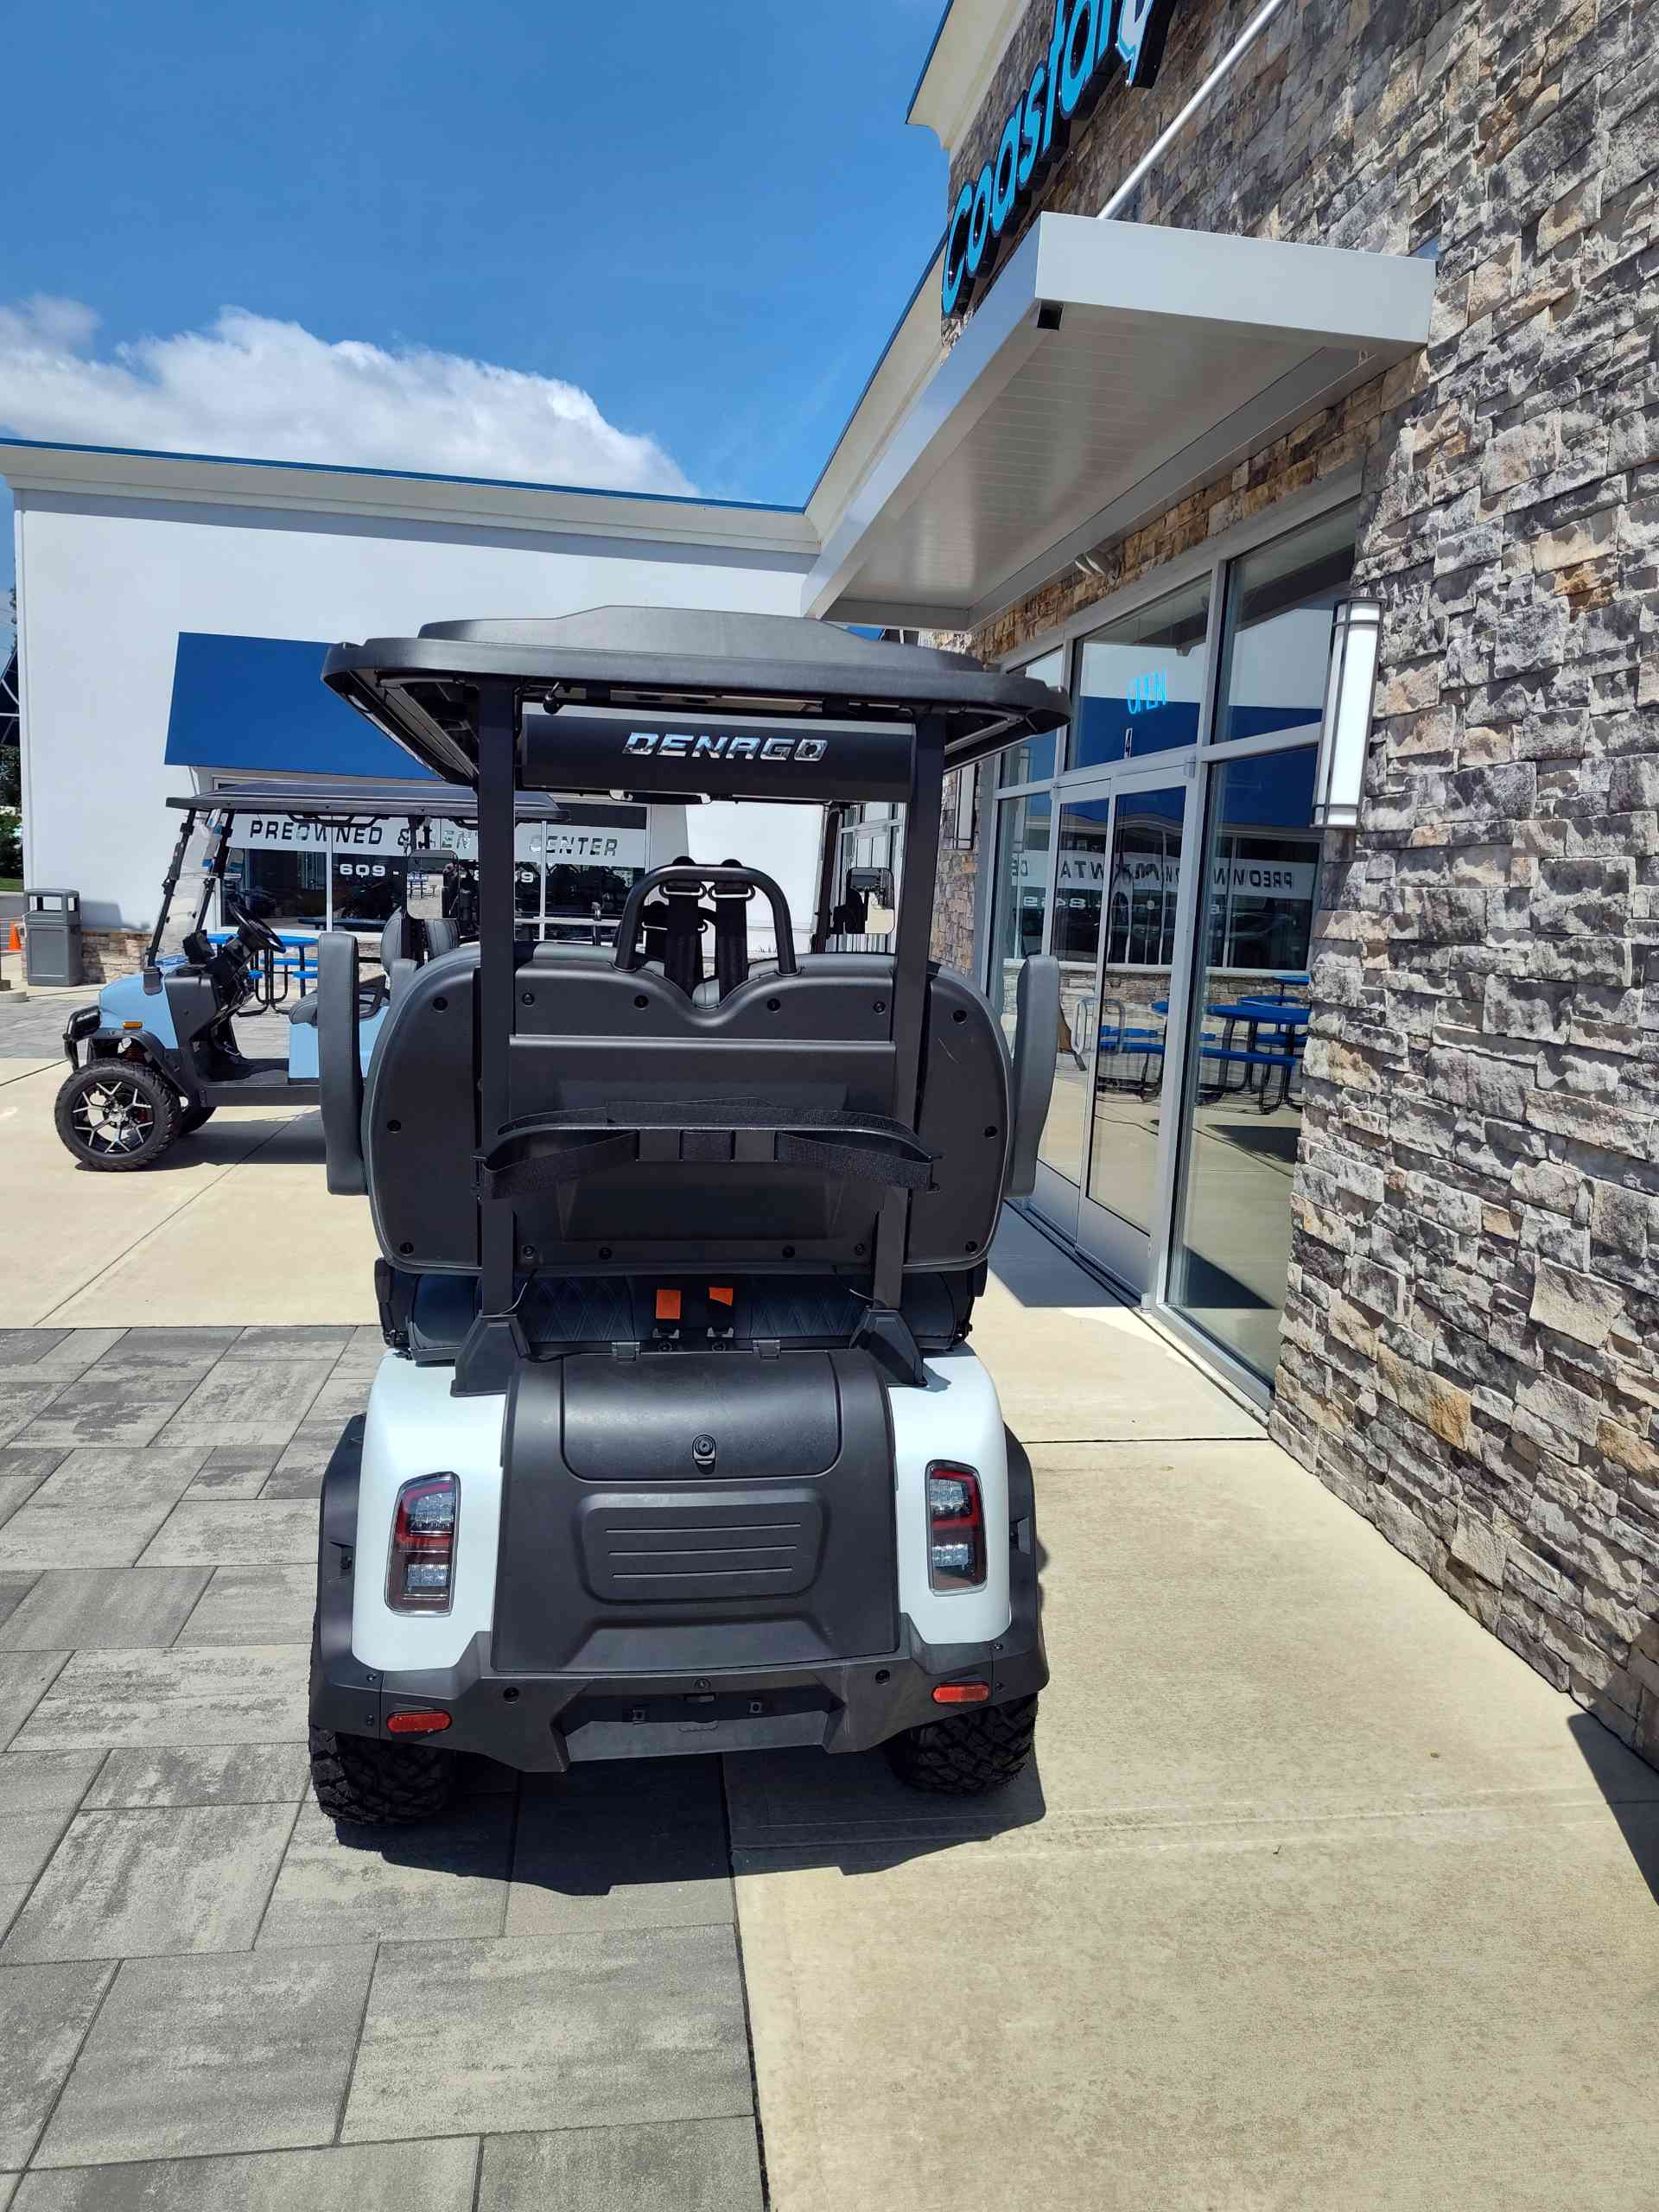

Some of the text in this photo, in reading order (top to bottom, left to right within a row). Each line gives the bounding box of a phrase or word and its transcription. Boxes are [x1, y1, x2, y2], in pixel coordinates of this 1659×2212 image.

[622, 732, 829, 761] DENAGO
[250, 820, 383, 845] PREOWNED
[529, 835, 619, 856] CENTER
